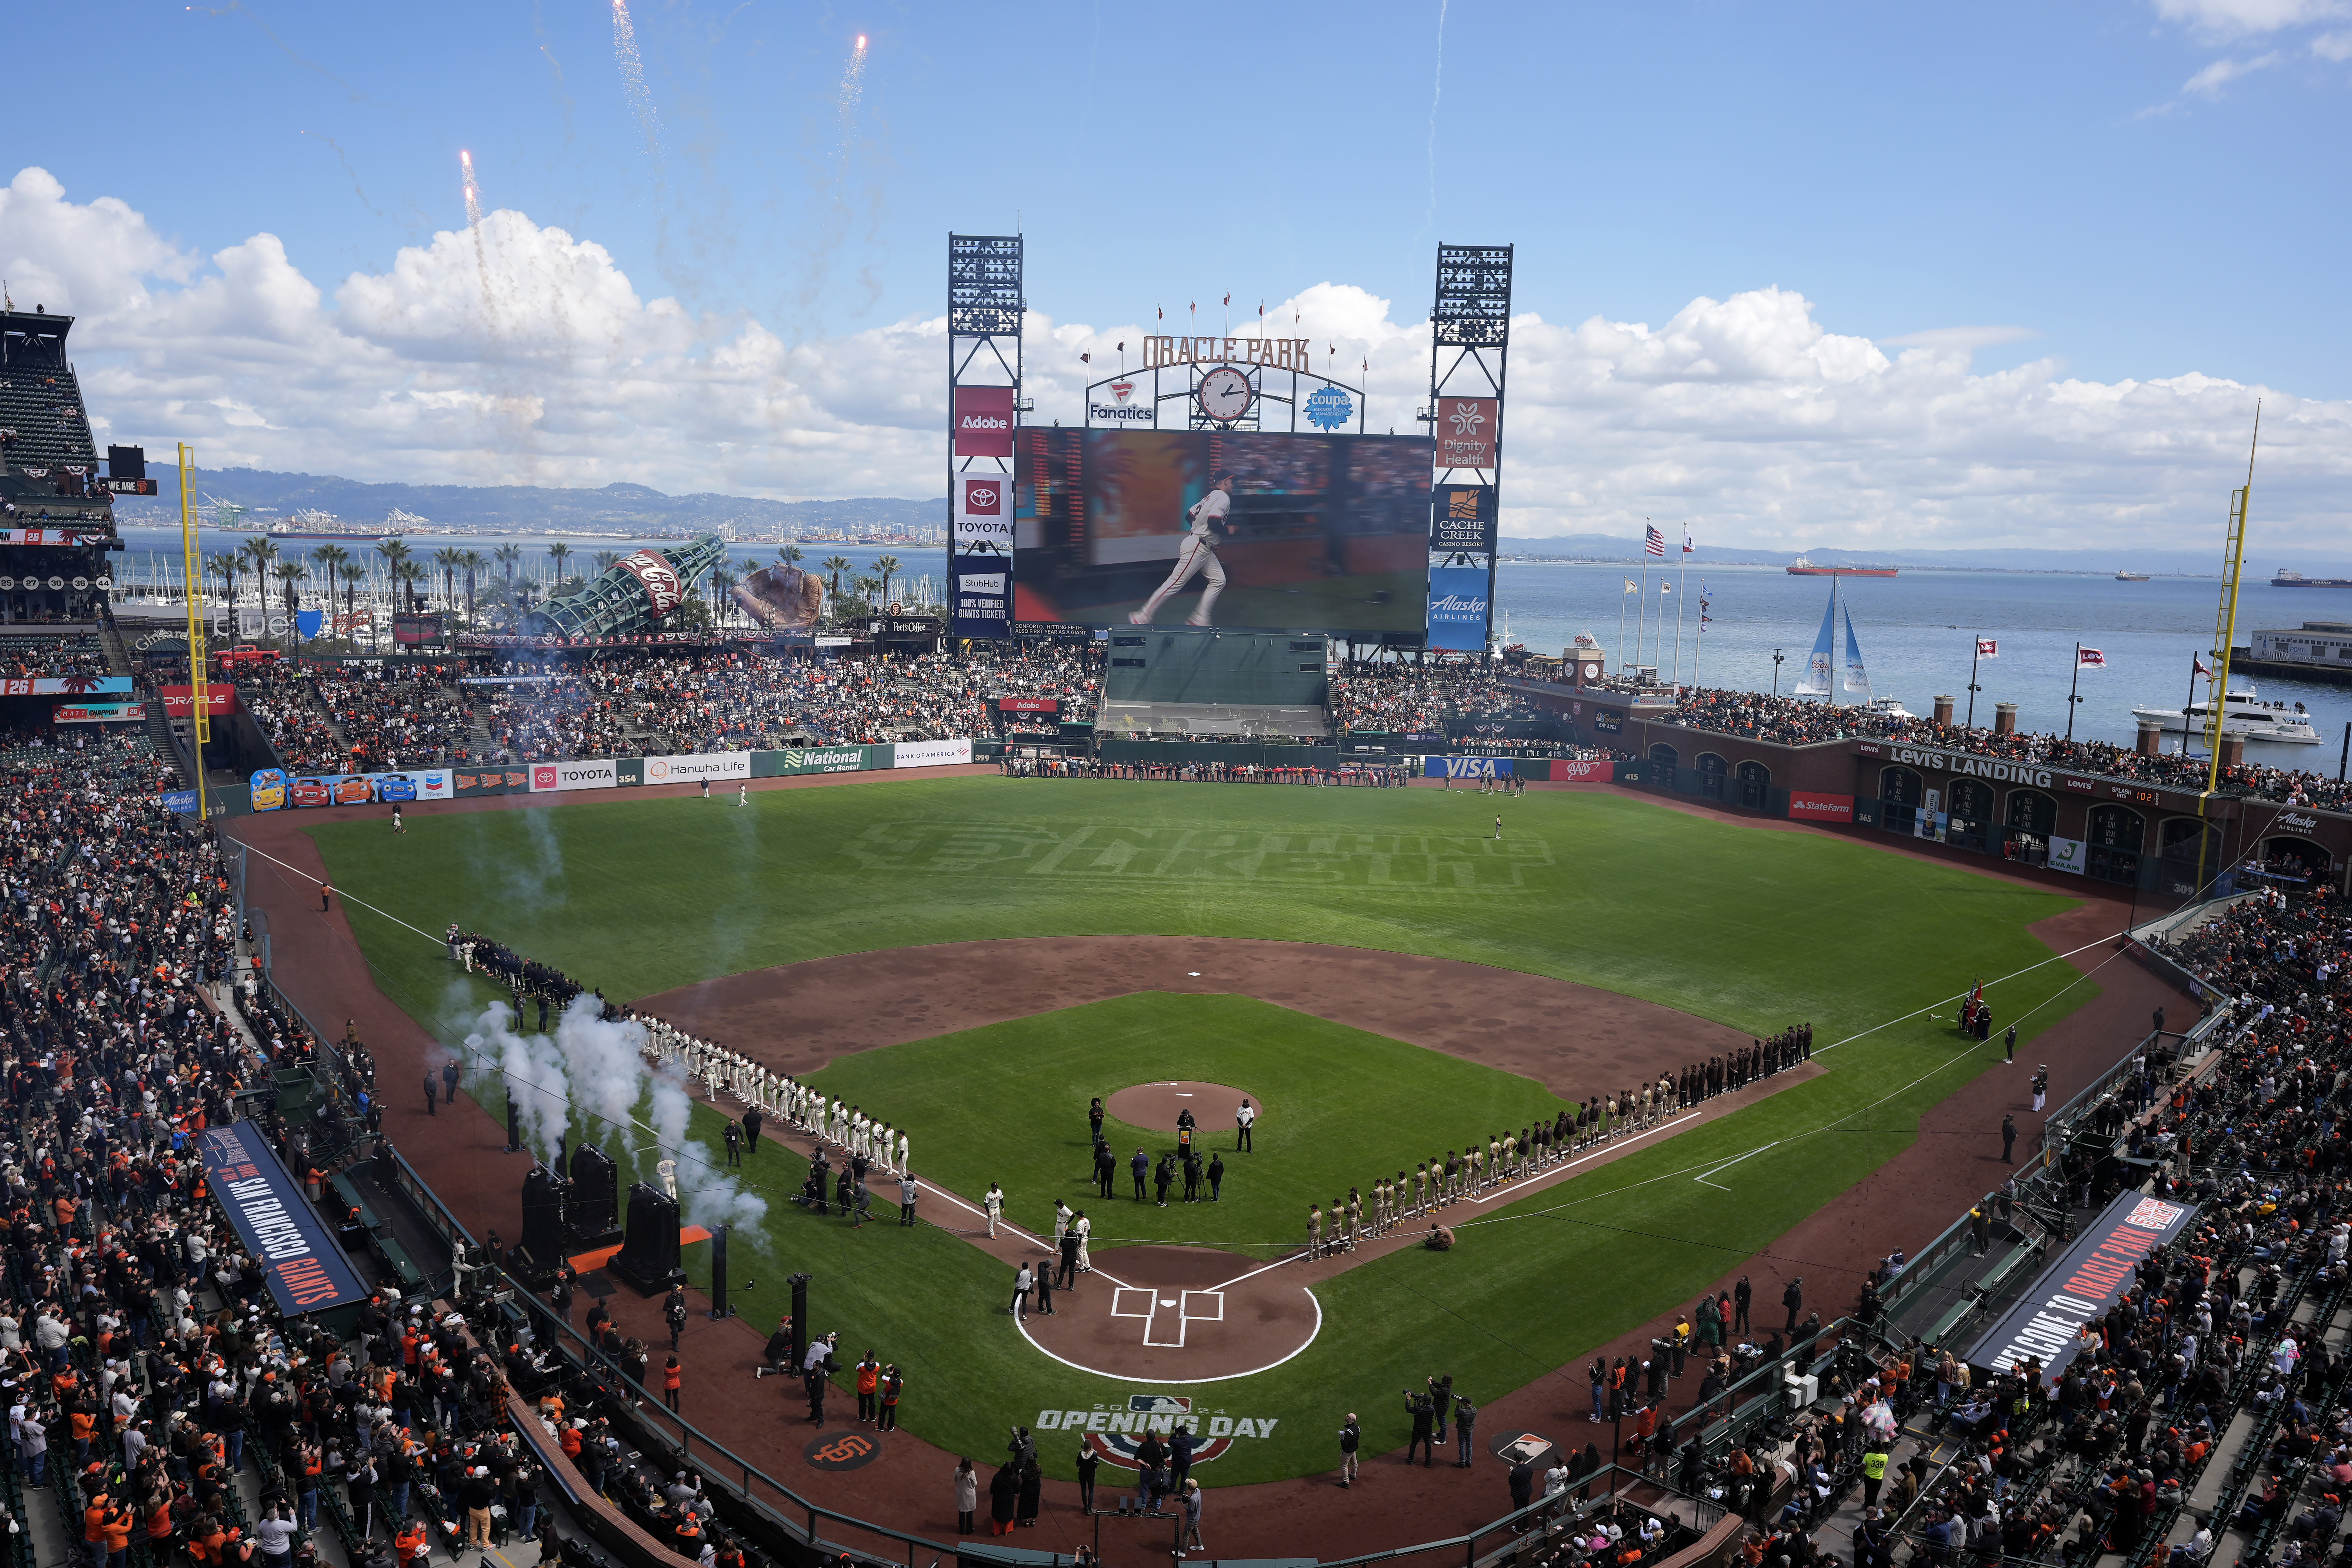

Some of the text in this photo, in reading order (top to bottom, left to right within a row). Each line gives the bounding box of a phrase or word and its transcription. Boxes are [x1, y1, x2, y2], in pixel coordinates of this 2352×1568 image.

[1143, 336, 1310, 374] ORACLE PARK
[1311, 395, 1348, 408] coupa
[1090, 404, 1152, 419] Fanatics
[961, 416, 1007, 429] Adobe
[1445, 439, 1486, 454] Dignity
[108, 481, 136, 491] WE ARE
[957, 522, 1008, 533] TOYOTA
[1439, 521, 1485, 530] CACHE
[27, 532, 40, 542] 26
[1440, 530, 1483, 540] CREEK
[965, 579, 999, 588] StubHub
[960, 598, 1004, 609] 100% VERIFIED
[1430, 594, 1486, 613] Alaska
[958, 609, 1006, 619] GIANTS TICKETS
[212, 609, 290, 636] blue
[893, 622, 926, 633] Peet's Coffee
[1433, 645, 1457, 655] Coors
[1811, 660, 1830, 669] Coors
[9, 680, 29, 694] 26
[163, 695, 225, 705] ORACLE
[1604, 714, 1622, 726] Sports
[803, 749, 862, 766] National
[671, 762, 744, 774] Hanwha Life
[837, 763, 859, 771] Rental
[1441, 758, 1497, 778] VISA
[1570, 765, 1589, 775] AAA
[1951, 757, 2052, 788] LANDING
[561, 769, 612, 781] TOYOTA
[618, 775, 637, 783] 354
[2111, 787, 2132, 795] SPLASH
[163, 794, 194, 806] Alaska
[2137, 792, 2152, 802] 102
[207, 805, 226, 816] 339
[1926, 793, 1935, 820] Corona
[1858, 813, 1872, 823] 365
[2277, 812, 2317, 829] Alaska
[2278, 824, 2312, 835] AIRLINES
[2050, 860, 2065, 869] EVA
[2173, 884, 2194, 896] 309
[236, 1163, 260, 1178] HOME
[221, 1172, 239, 1182] THE
[227, 1177, 339, 1305] SAN FRANCISCO GIANTS
[2099, 1224, 2160, 1258] PARK
[2062, 1252, 2136, 1299] ORACLE
[2045, 1294, 2098, 1317] TO
[2288, 1350, 2297, 1359] 23
[1198, 1407, 1226, 1416] 24
[1035, 1410, 1279, 1439] OPENING DAY
[1871, 1459, 1885, 1468] 338
